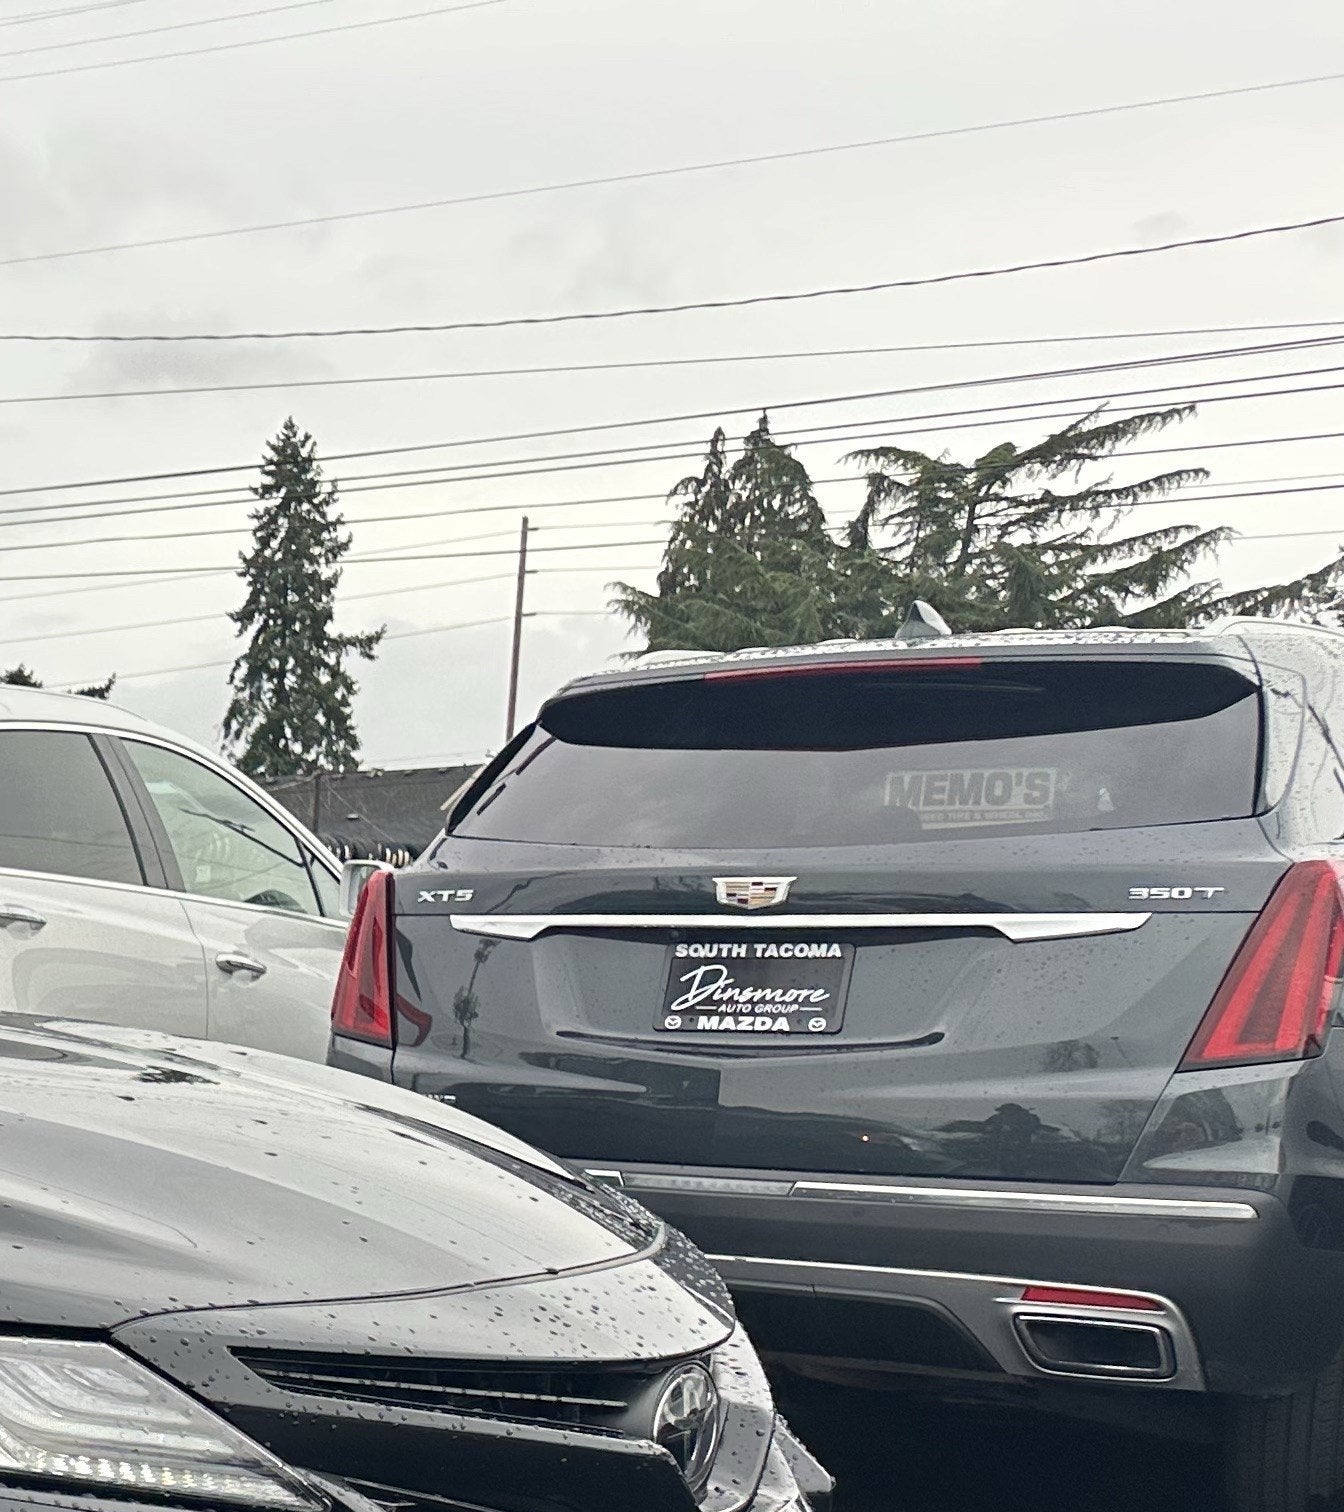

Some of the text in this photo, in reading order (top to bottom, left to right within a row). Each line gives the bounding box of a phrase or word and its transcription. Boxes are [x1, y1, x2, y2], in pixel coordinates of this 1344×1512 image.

[886, 770, 1053, 807] MEMO'S
[417, 889, 474, 903] XT5
[1128, 887, 1225, 900] 350T
[674, 943, 842, 958] SOUTH TACOMA
[670, 964, 831, 1011] Dinsmore
[717, 1003, 800, 1014] AUTO GROUP
[696, 1015, 791, 1032] MAZDA
